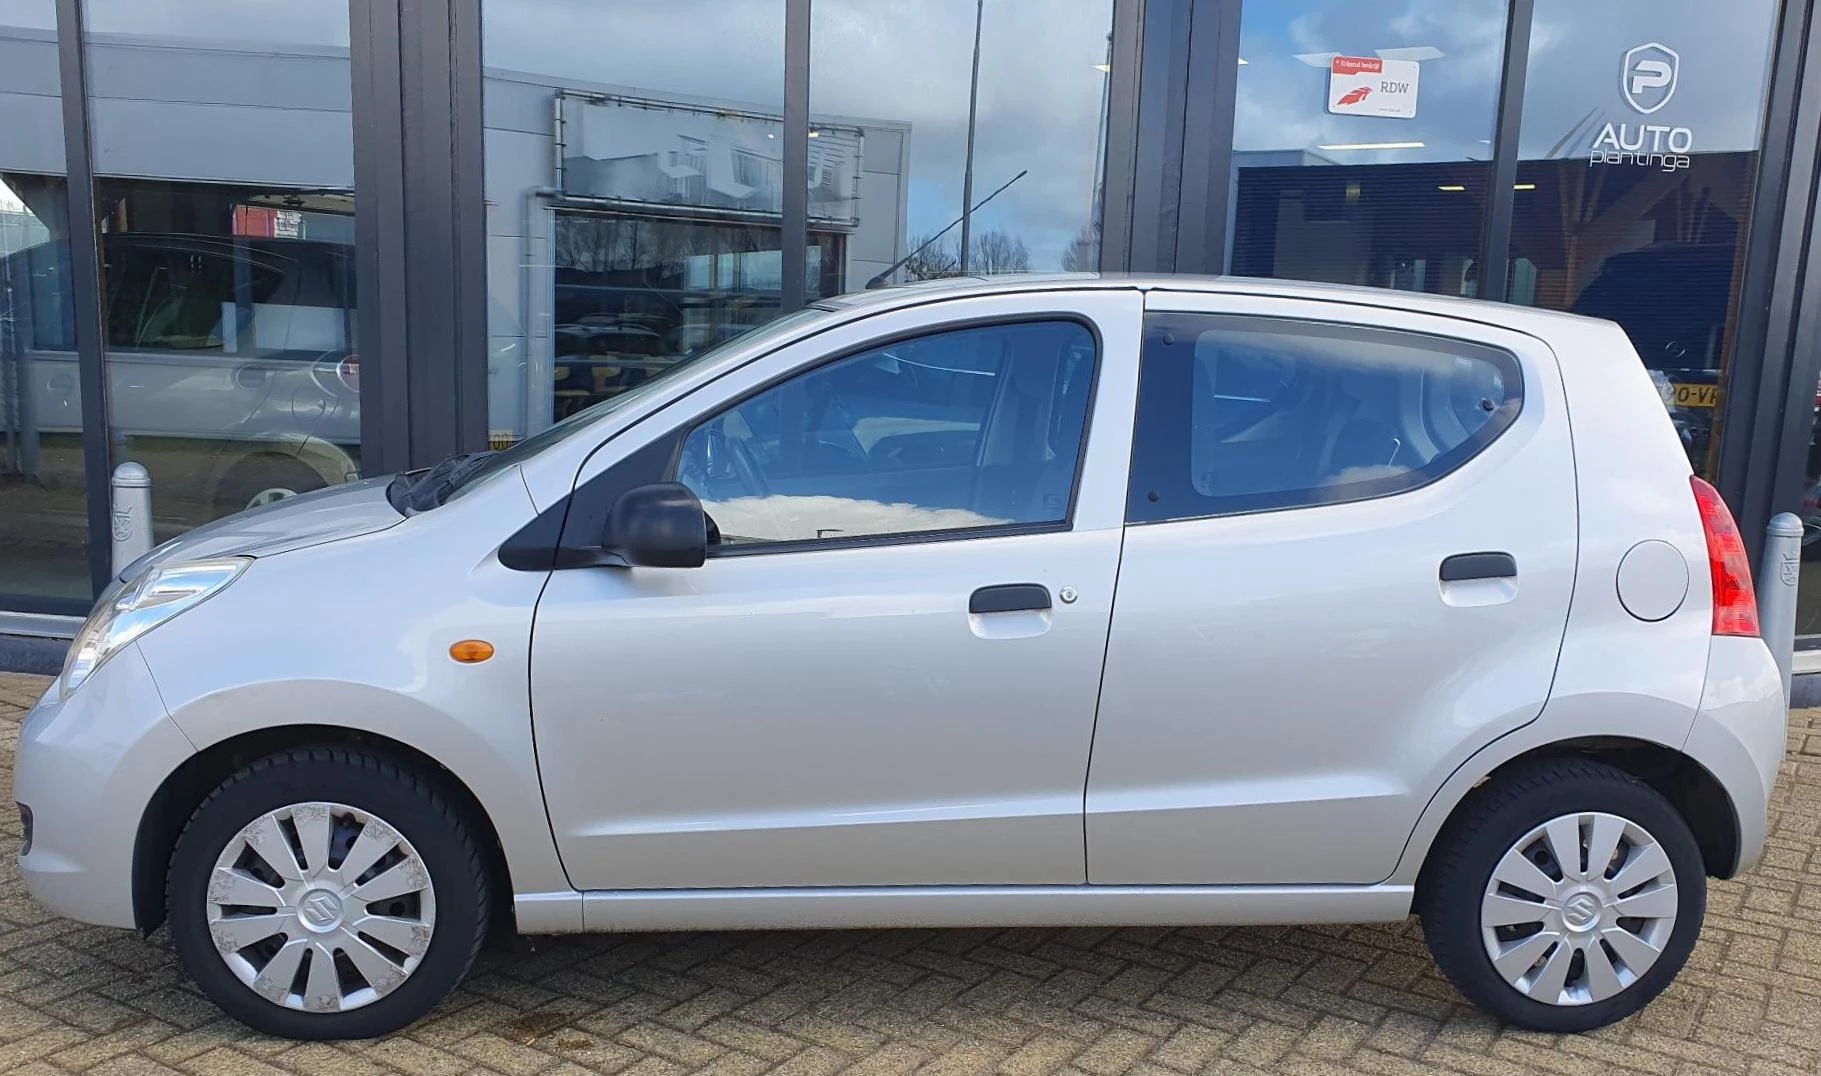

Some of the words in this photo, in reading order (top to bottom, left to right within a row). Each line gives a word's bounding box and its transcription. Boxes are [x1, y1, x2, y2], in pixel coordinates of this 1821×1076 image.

[1380, 81, 1409, 94] RDW
[1632, 60, 1672, 94] P
[1592, 122, 1693, 154] AUTO
[1589, 149, 1690, 172] plantinga
